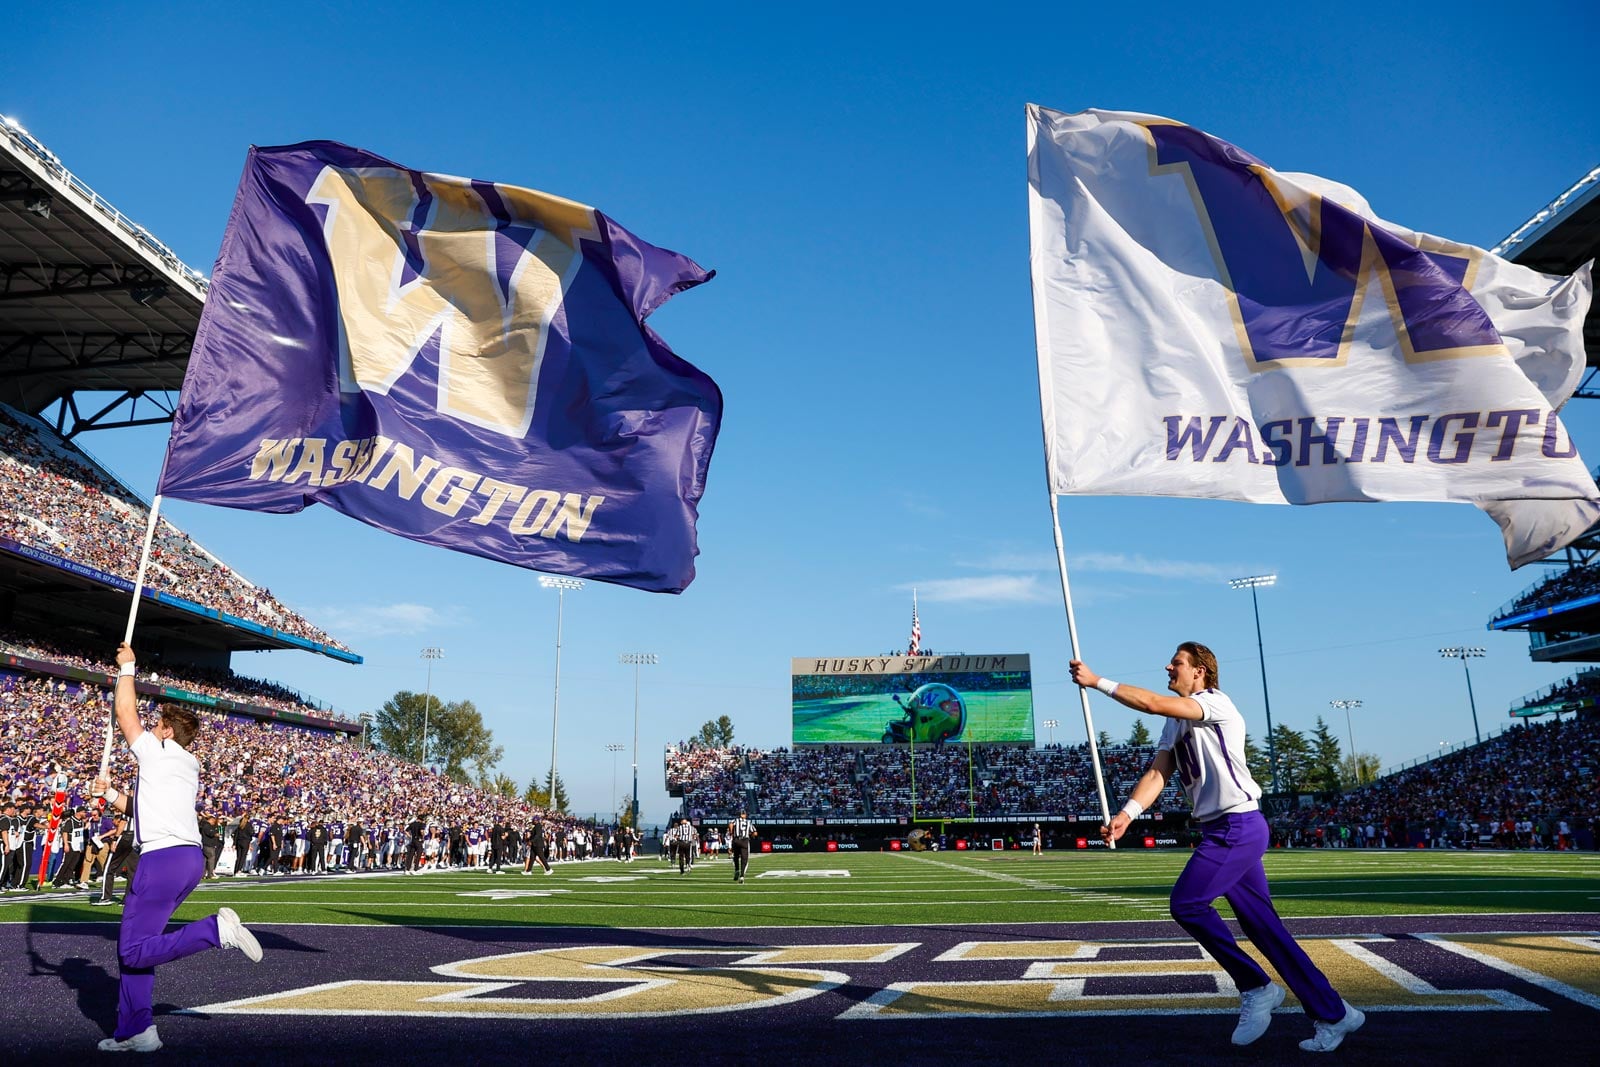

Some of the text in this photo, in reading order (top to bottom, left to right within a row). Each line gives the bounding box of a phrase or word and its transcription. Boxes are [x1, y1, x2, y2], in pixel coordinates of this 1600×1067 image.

[305, 162, 603, 440] W
[1163, 408, 1577, 466] WASHINGTO
[814, 656, 1008, 673] HUSKY STADIUM
